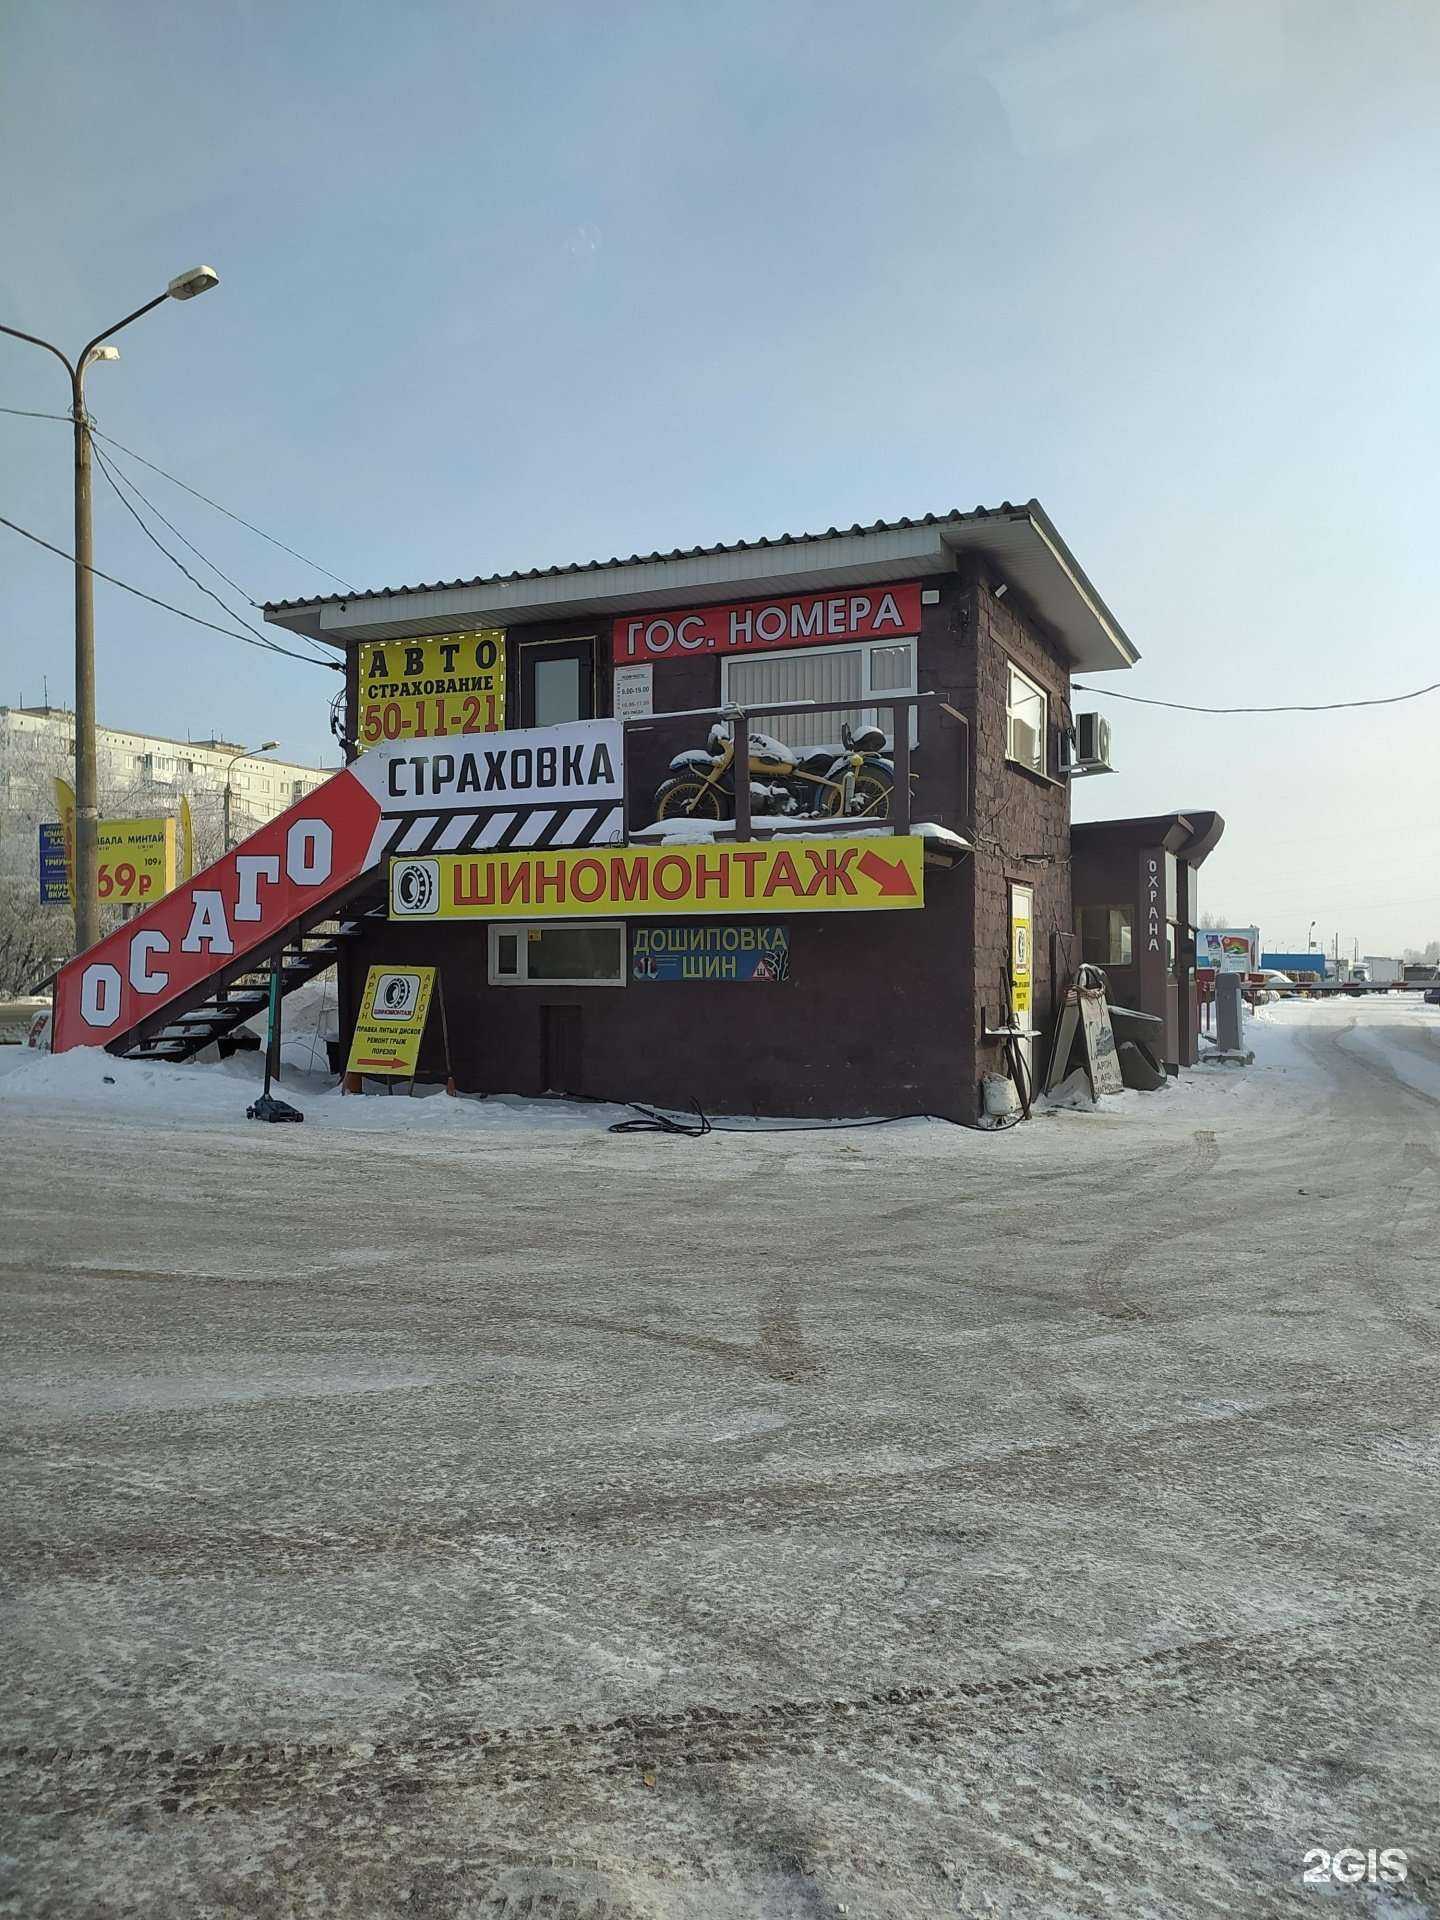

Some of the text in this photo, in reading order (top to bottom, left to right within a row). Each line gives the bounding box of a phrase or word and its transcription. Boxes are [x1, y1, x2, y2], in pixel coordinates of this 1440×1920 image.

[627, 594, 904, 656] ГОС. НОМЕРА
[368, 639, 497, 678] АВТО
[368, 675, 494, 699] СТРАХОВАНИЕ
[364, 694, 500, 742] 50-11-21
[388, 743, 616, 798] СТРАХОВКА
[127, 832, 164, 845] МИНТАЙ
[452, 847, 859, 907] ШИНОМОНТАЖ
[80, 817, 334, 1028] ОСАГО
[1147, 859, 1160, 952] ОХРАНА
[633, 927, 788, 955] ДОШИПОВКА
[682, 955, 737, 978] ШИН
